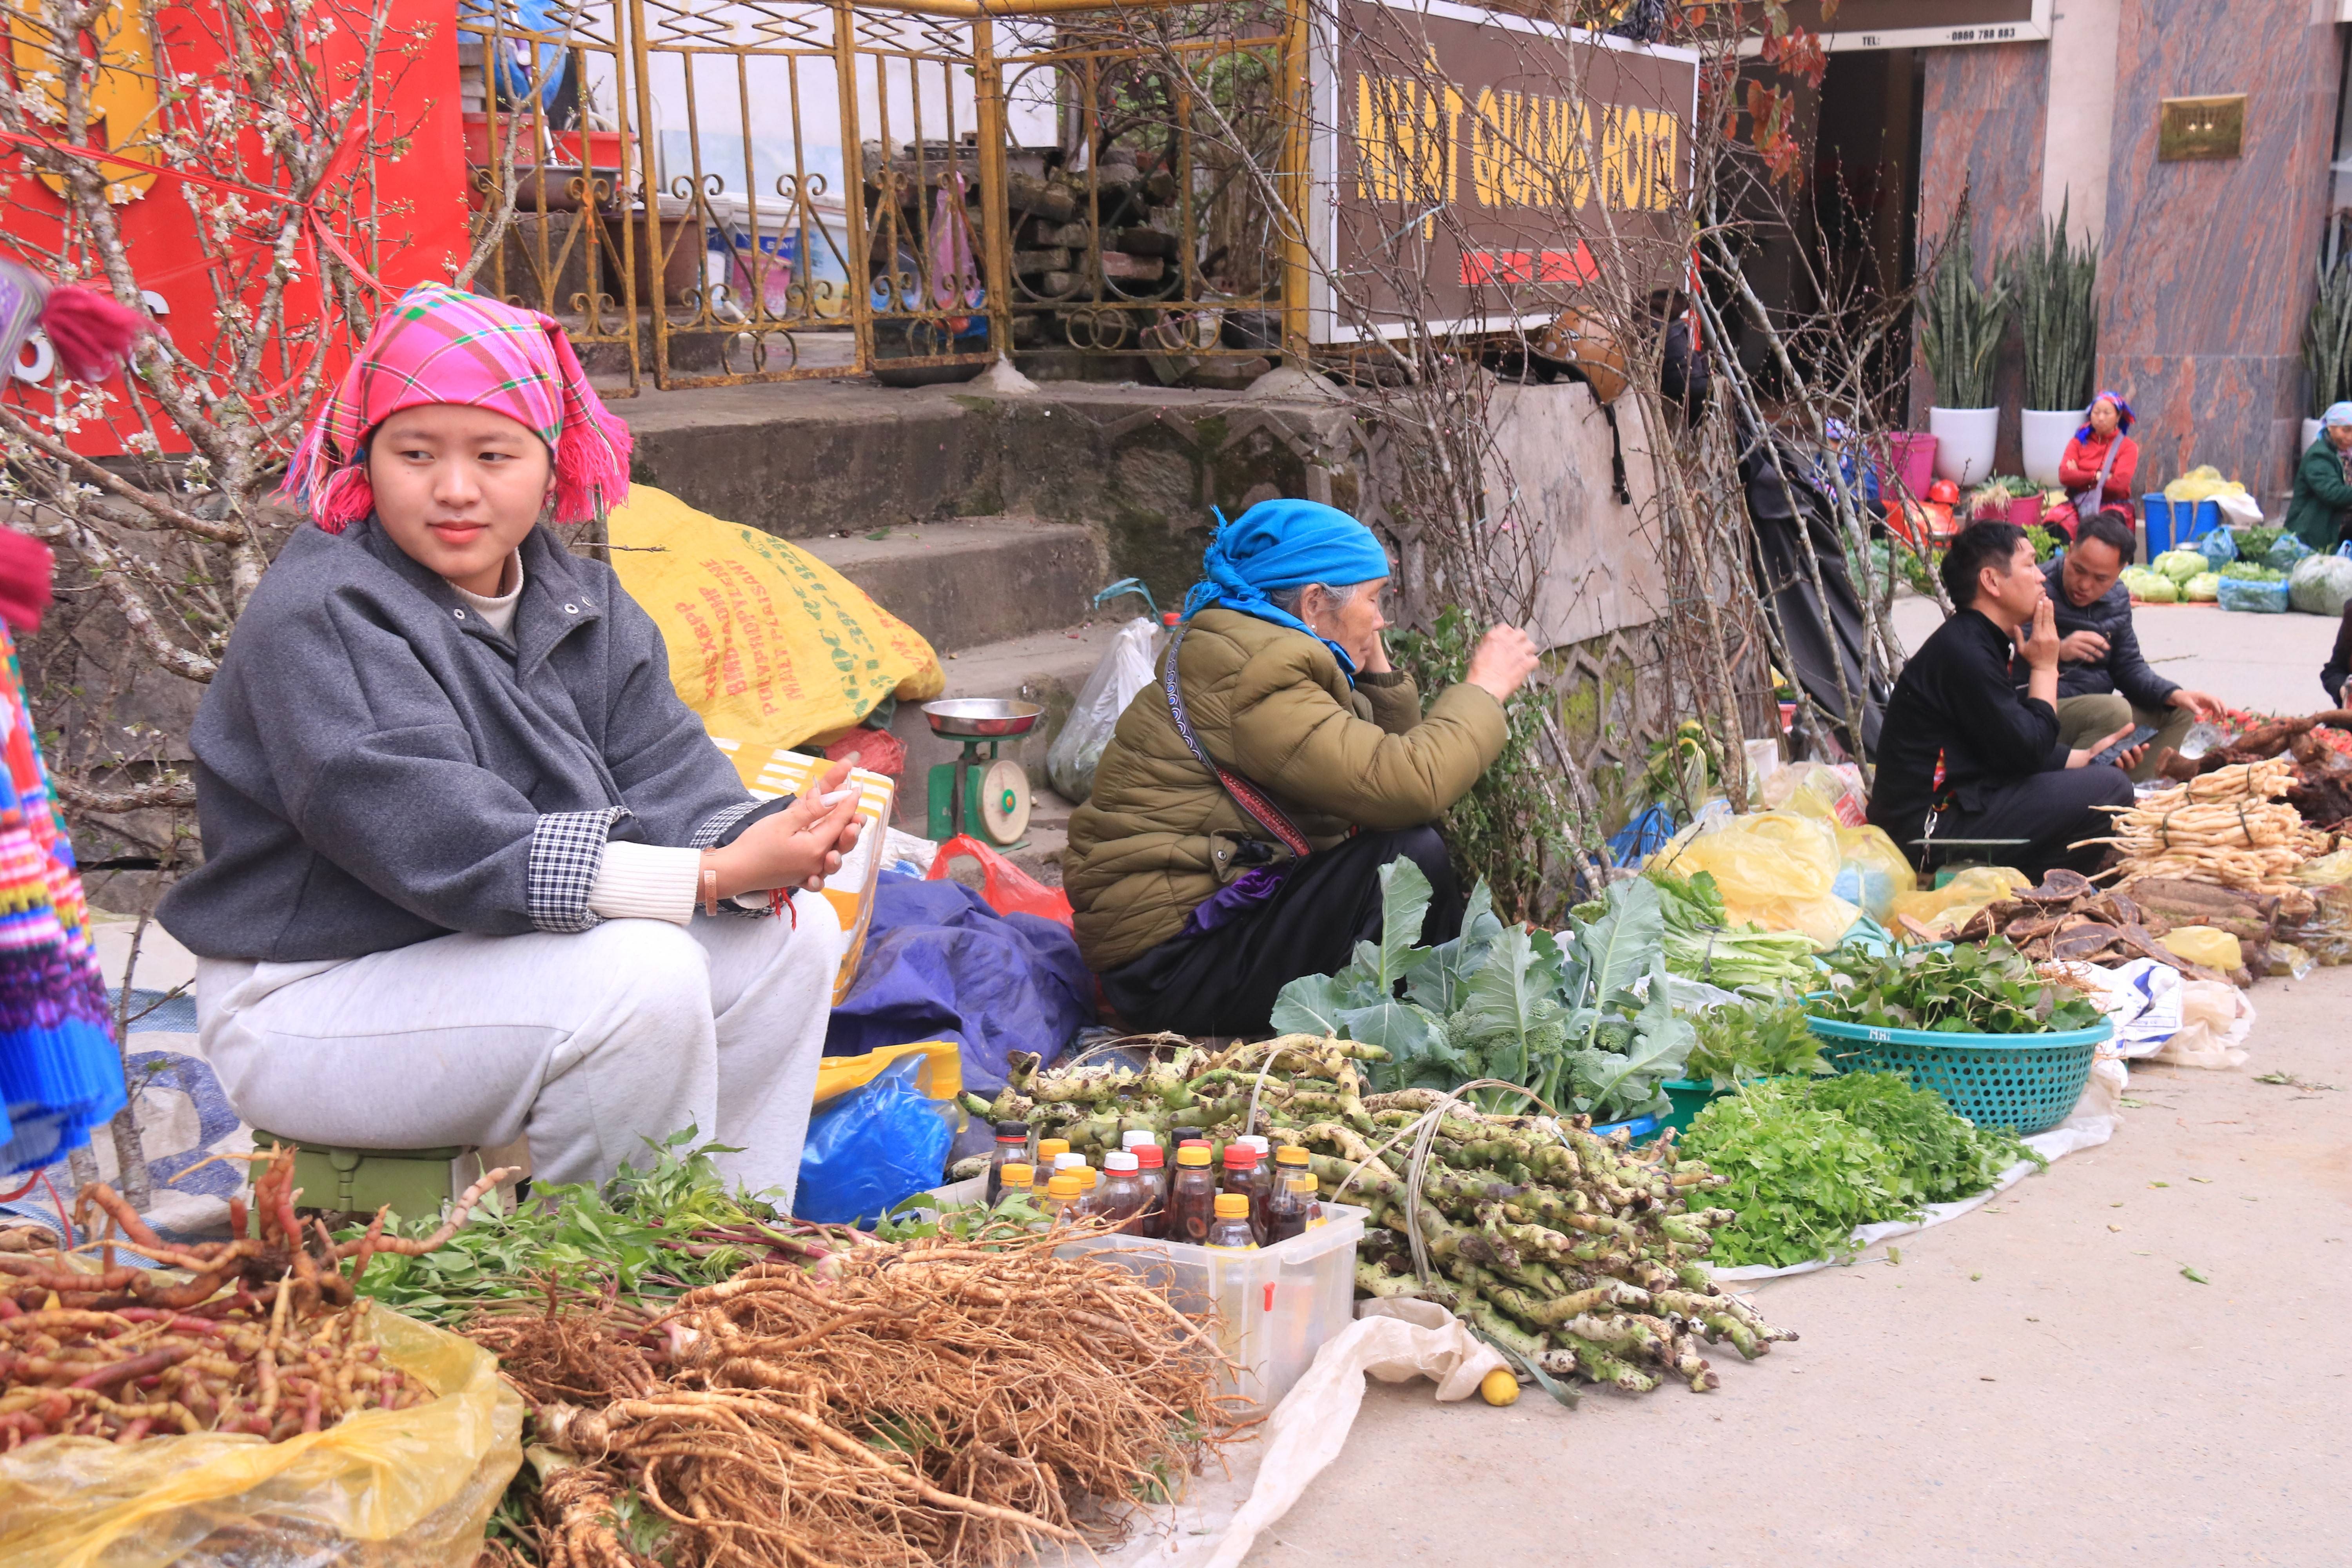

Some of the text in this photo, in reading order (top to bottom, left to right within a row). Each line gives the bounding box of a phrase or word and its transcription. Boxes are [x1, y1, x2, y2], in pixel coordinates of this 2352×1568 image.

[1862, 36, 1880, 46] TEL:
[1601, 106, 1679, 212] HOTEL
[699, 559, 779, 717] POLYPROPYLENE
[725, 558, 805, 701] MALT PLAISANT
